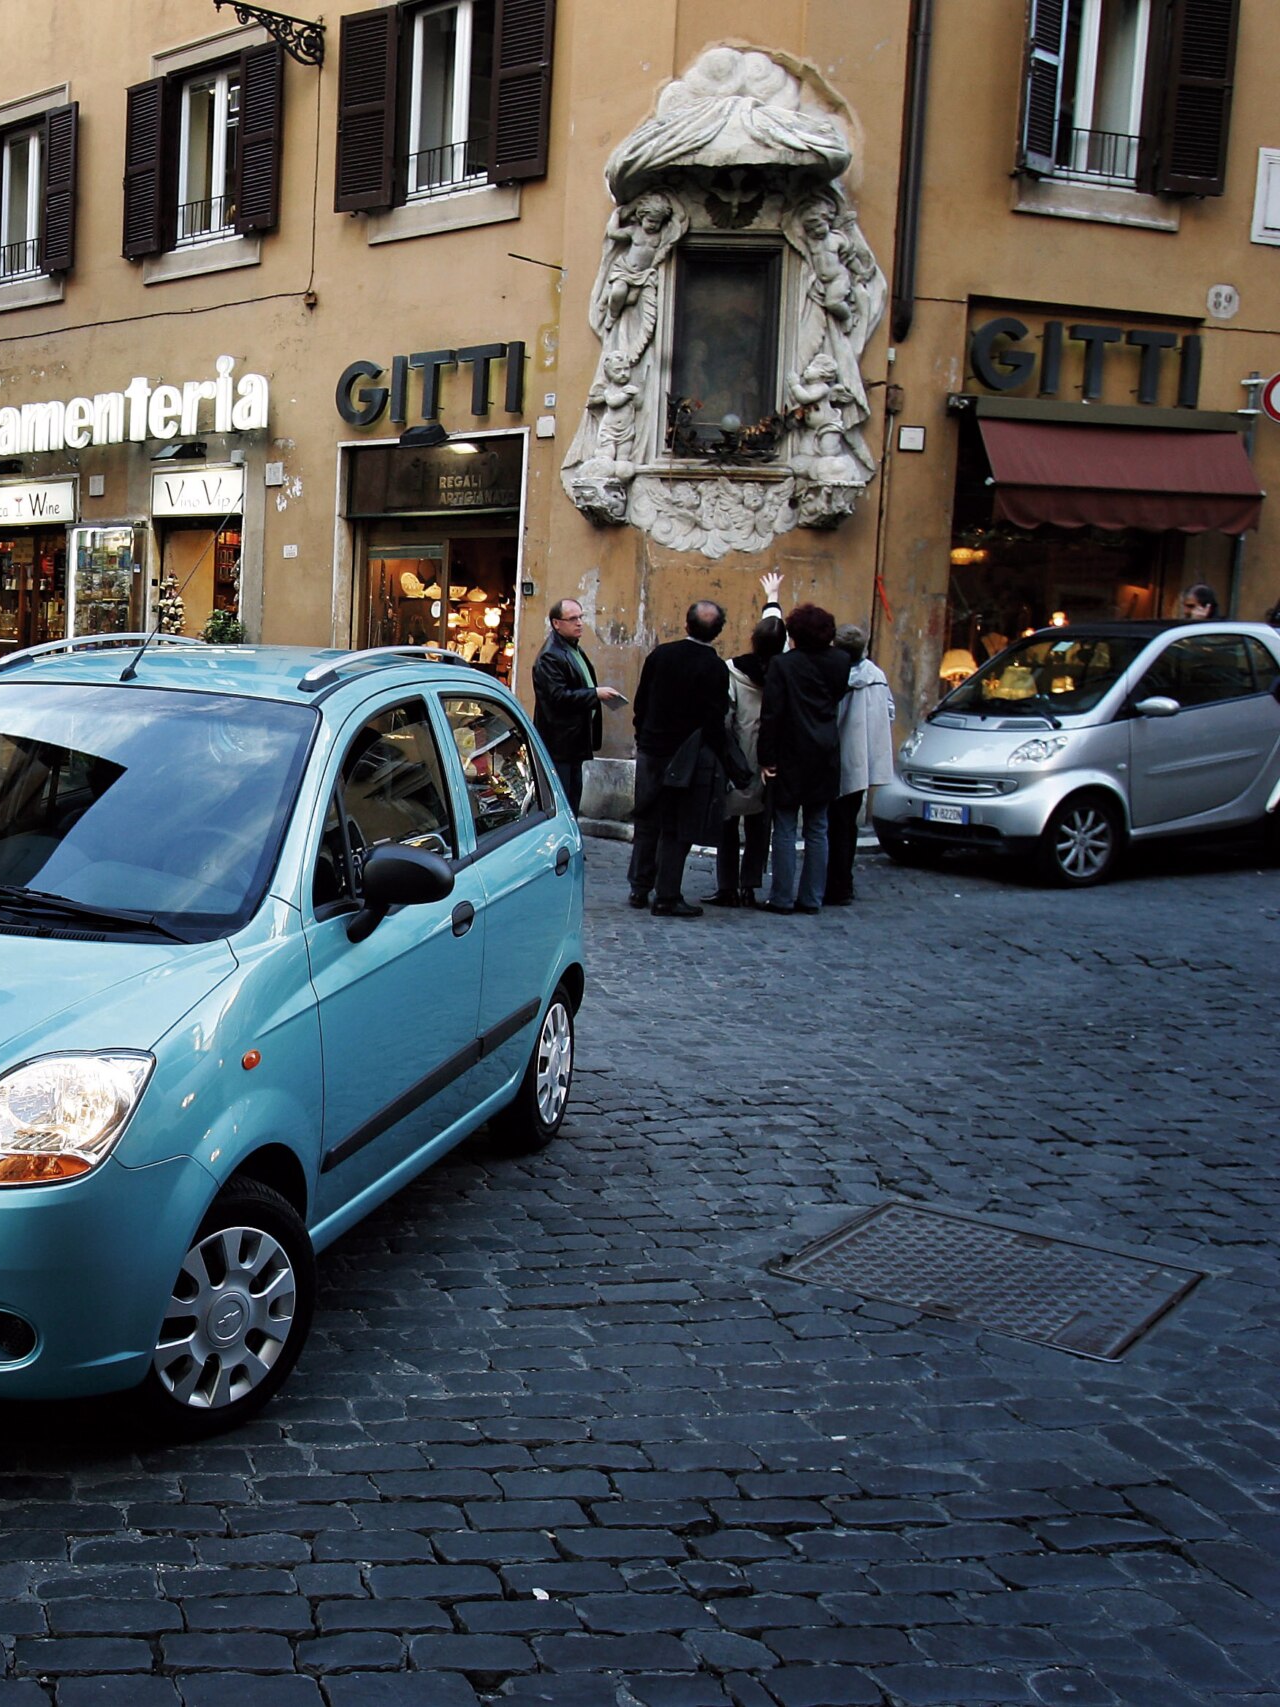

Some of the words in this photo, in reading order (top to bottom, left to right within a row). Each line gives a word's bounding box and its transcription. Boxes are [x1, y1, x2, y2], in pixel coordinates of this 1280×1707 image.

[970, 317, 1202, 409] GITTI
[335, 341, 526, 427] GITTI
[164, 479, 200, 508] Vino
[201, 477, 231, 513] Vip
[439, 475, 482, 489] REGALI
[29, 492, 61, 517] Wine
